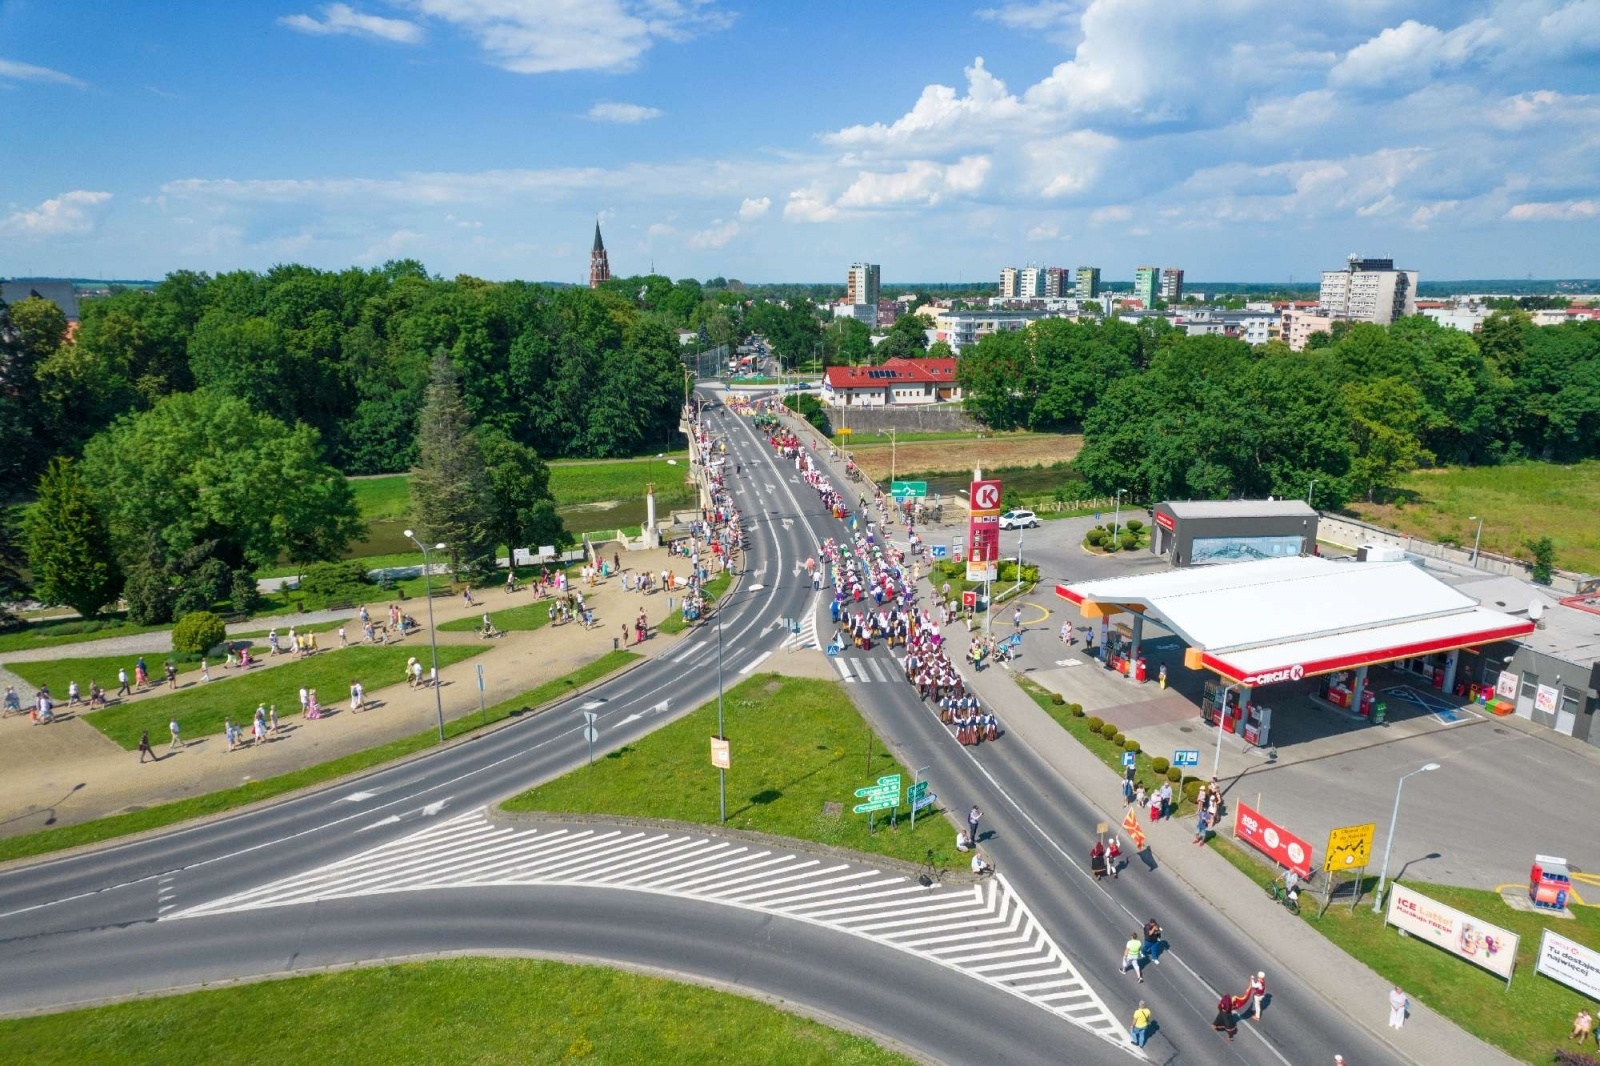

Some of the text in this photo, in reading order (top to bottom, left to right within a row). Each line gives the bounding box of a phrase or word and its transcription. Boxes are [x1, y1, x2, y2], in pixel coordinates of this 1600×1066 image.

[981, 487, 998, 507] K
[1257, 669, 1290, 685] CIRCLE
[1397, 906, 1452, 933] Marakuja FRESH
[1398, 897, 1453, 927] ICE Latte!
[1548, 945, 1560, 955] Tu
[1547, 953, 1588, 976] najwięcej
